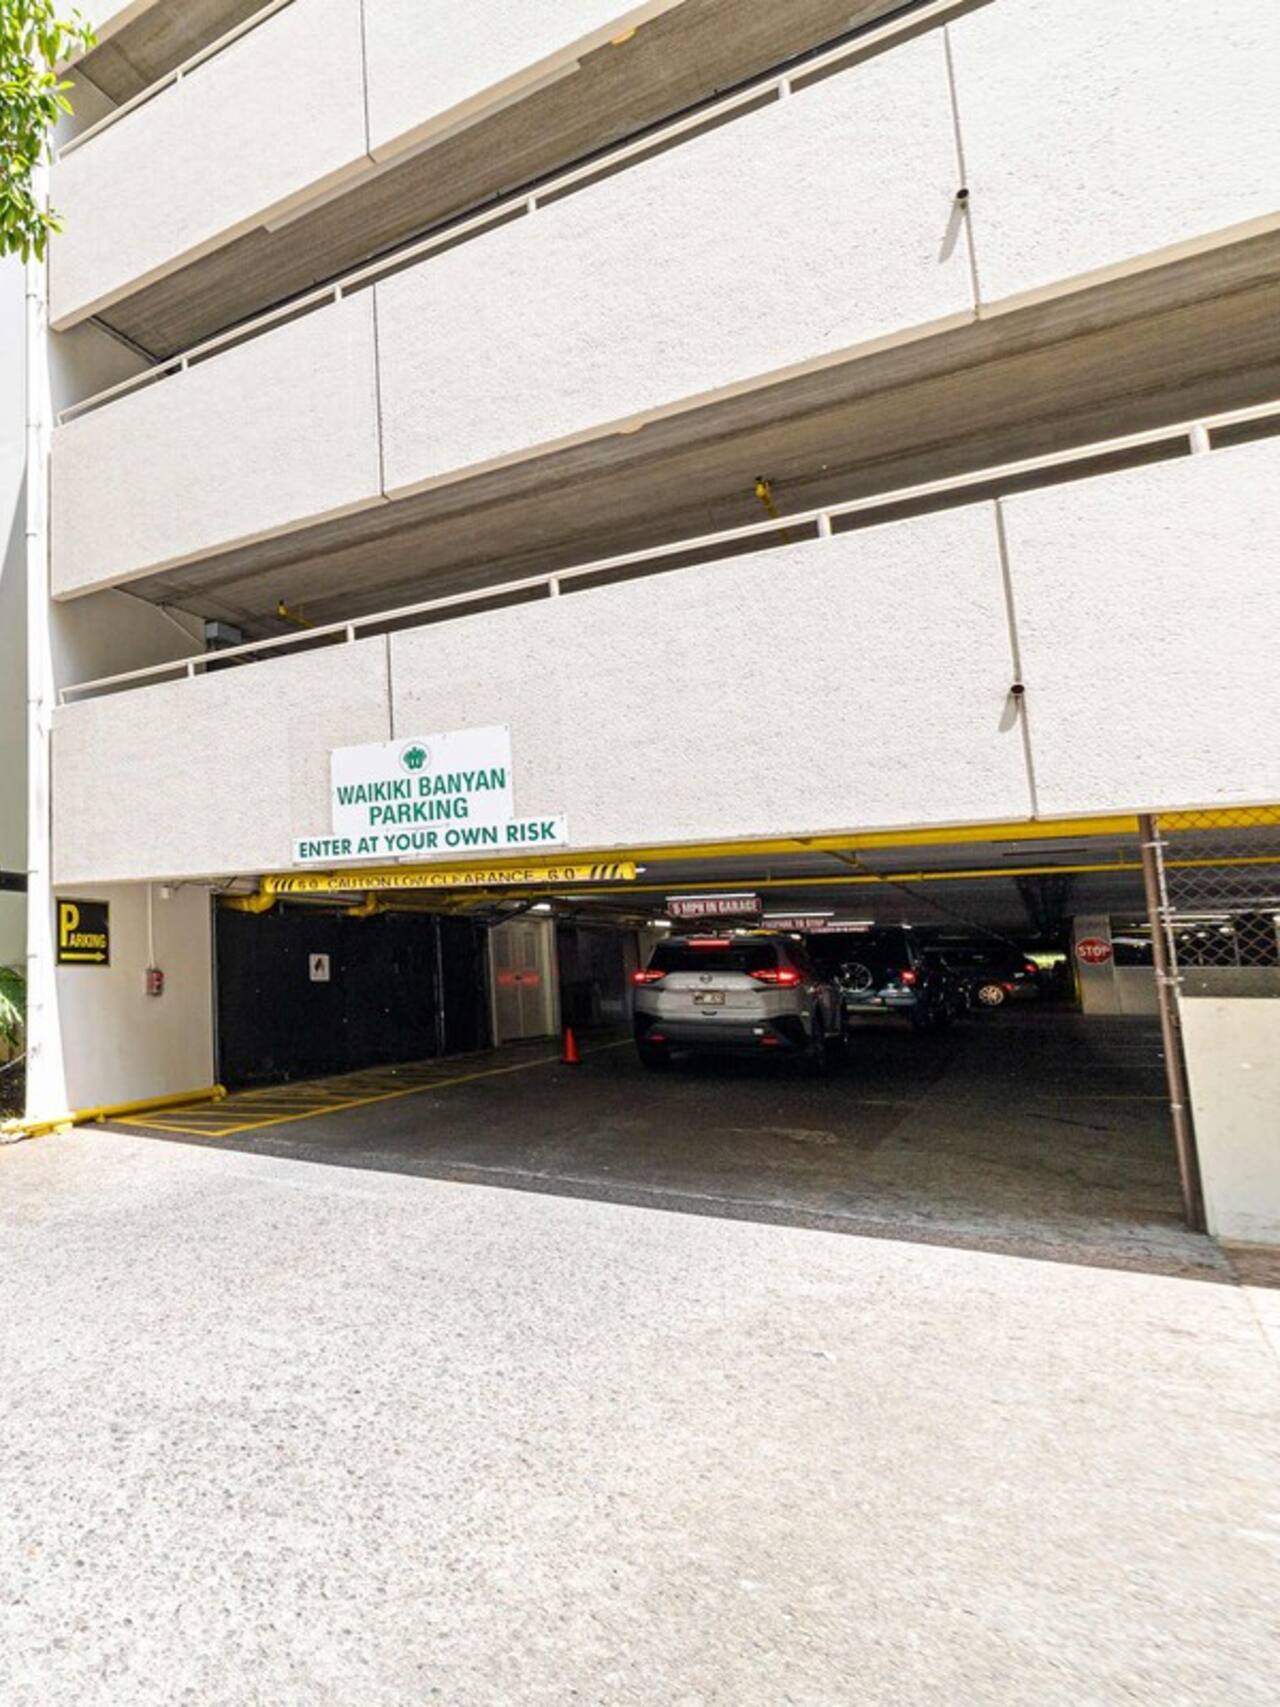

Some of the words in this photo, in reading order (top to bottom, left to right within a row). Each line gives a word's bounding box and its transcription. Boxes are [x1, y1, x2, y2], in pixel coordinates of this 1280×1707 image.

[337, 778, 411, 805] WAIKIKI
[419, 767, 506, 797] BANYAN
[370, 797, 468, 826] PARKING
[299, 838, 351, 858] ENTER
[357, 836, 378, 853] AT
[385, 831, 438, 851] YOUR
[445, 826, 497, 846] OWN
[506, 821, 555, 842] RISK
[430, 871, 534, 885] CLEARANCE
[1078, 946, 1110, 957] STOP
